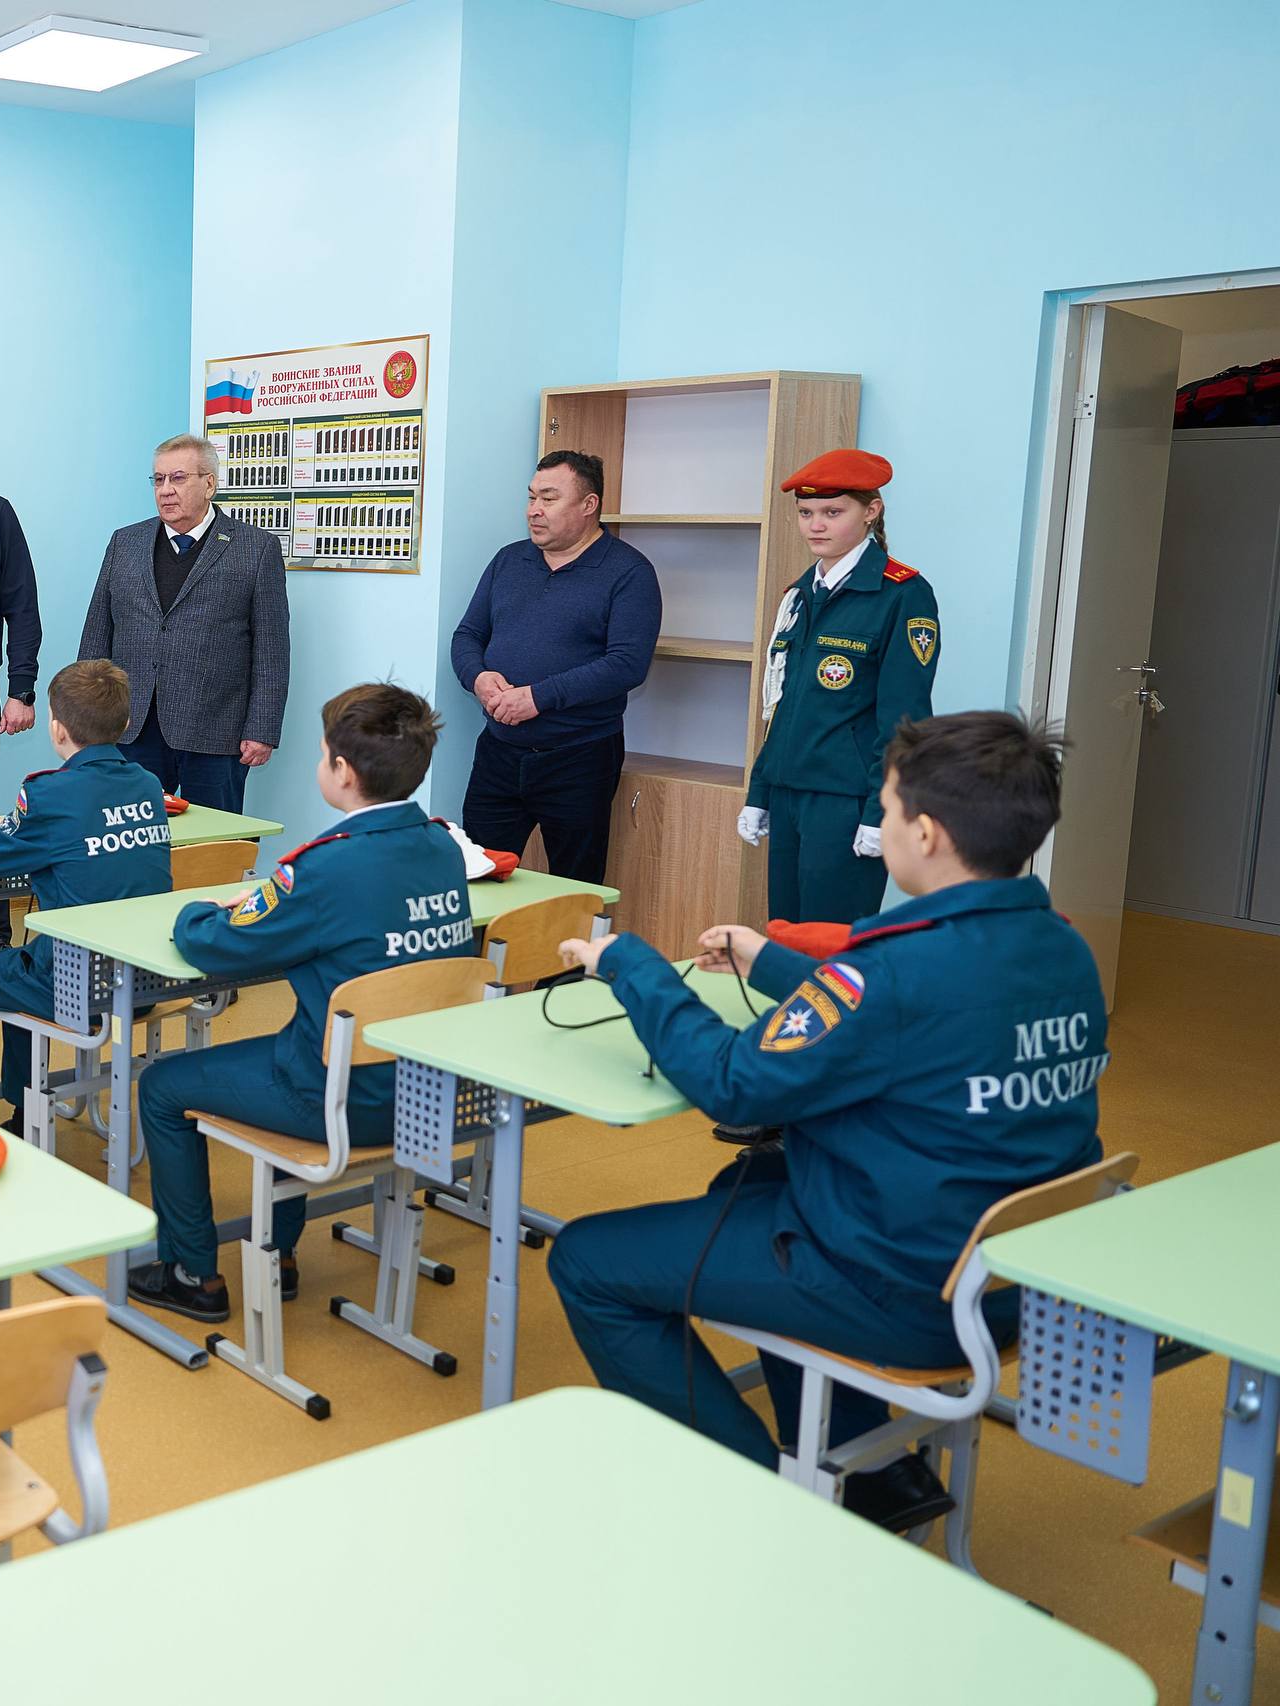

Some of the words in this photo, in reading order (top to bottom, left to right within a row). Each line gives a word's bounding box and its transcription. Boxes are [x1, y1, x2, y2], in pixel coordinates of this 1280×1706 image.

[260, 386, 266, 395] В
[268, 379, 340, 395] ВООРУЖЕННЫХ
[342, 376, 375, 388] СИЛАХ
[272, 368, 320, 382] ВОИНСКИЕ
[323, 364, 361, 377] ЗВАНИЯ
[257, 392, 317, 407] РОССИЙСКОЙ
[319, 388, 378, 403] ФЕДЕРАЦИИ
[102, 801, 154, 827] МЧС
[84, 824, 171, 857] РОССИИ
[405, 889, 461, 922] МЧС
[385, 916, 474, 957] РОССИИ
[1014, 1012, 1089, 1063] МЧС
[965, 1052, 1111, 1114] РОССИИ
